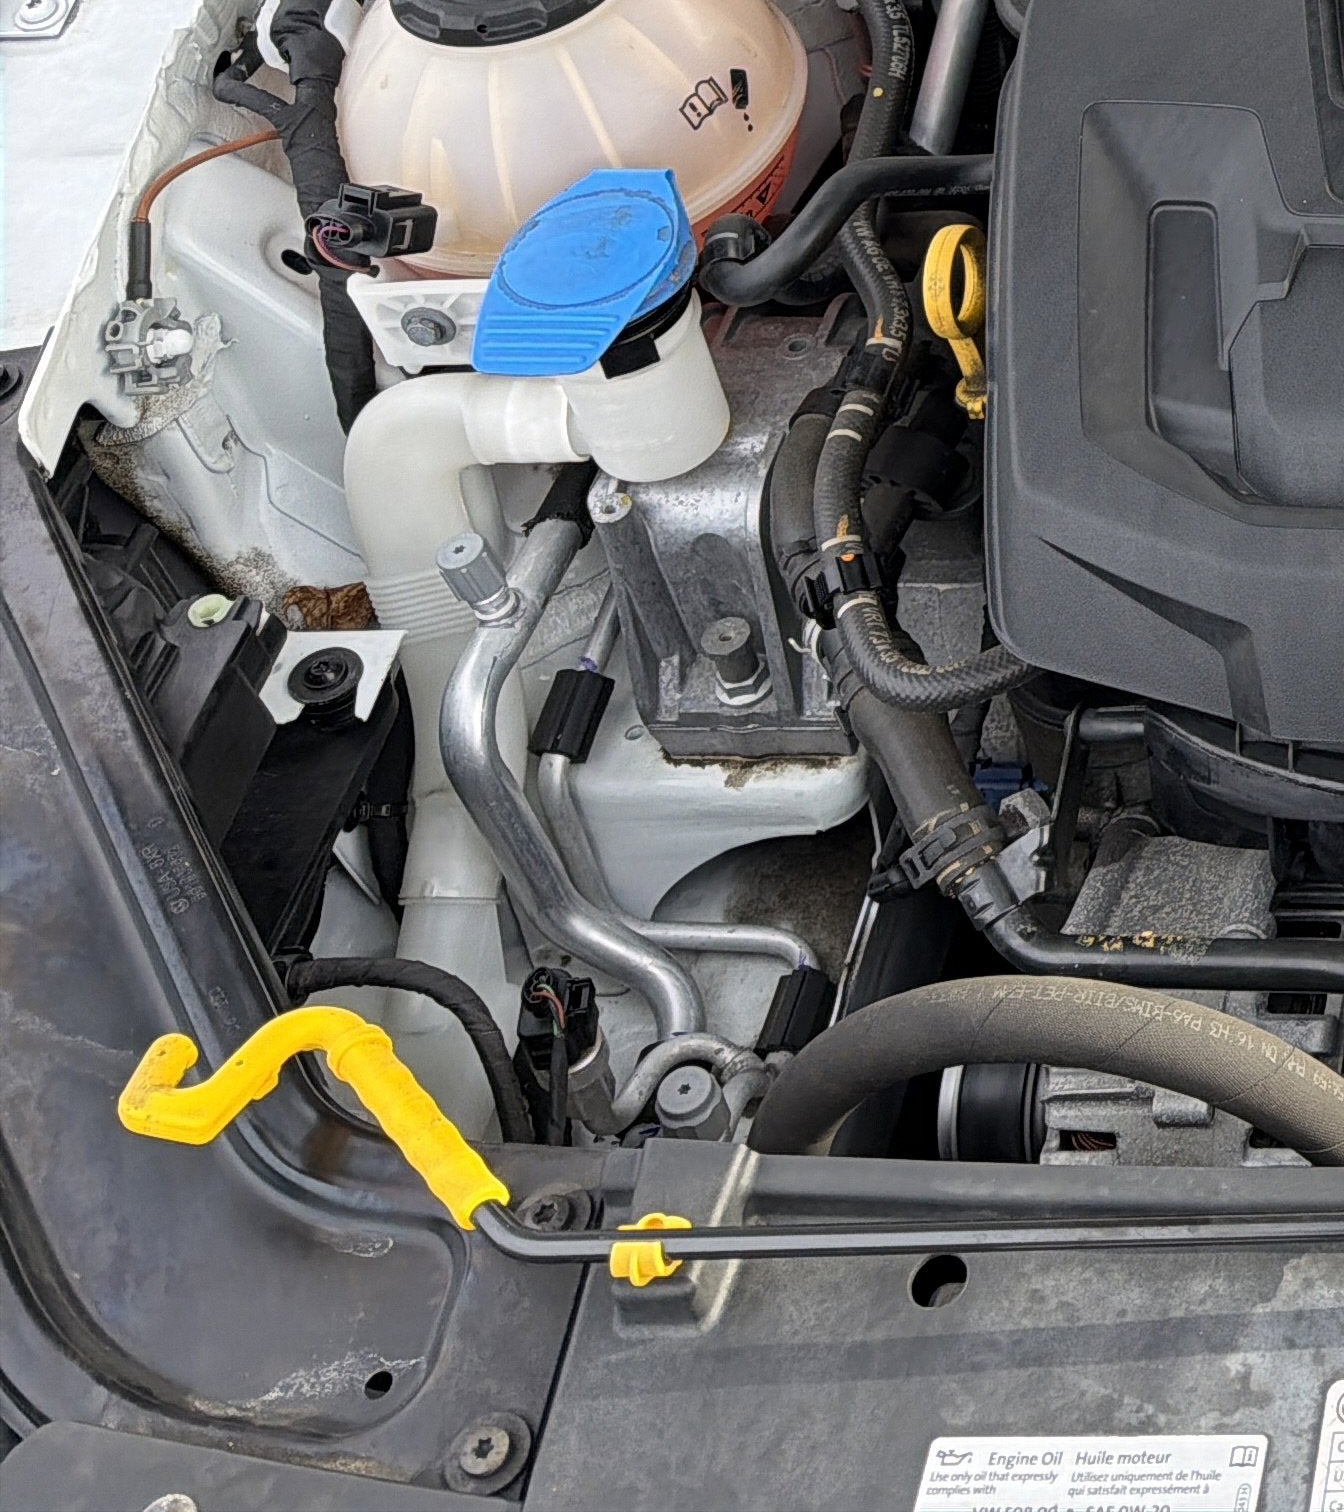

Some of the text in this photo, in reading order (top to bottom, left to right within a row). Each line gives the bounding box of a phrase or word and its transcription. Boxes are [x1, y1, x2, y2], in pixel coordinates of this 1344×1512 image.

[988, 1451, 1063, 1470] Engine Oil
[1075, 1451, 1172, 1465] Huile moteur
[930, 1471, 1058, 1485] Use only oil that expressly
[1071, 1471, 1109, 1483] Utilisez
[1111, 1471, 1173, 1483] uniquement
[1175, 1470, 1188, 1481] de
[926, 1485, 996, 1498] complies with
[1068, 1487, 1085, 1498] qui
[1087, 1484, 1126, 1495] satisfait
[1129, 1484, 1200, 1497] expressément
